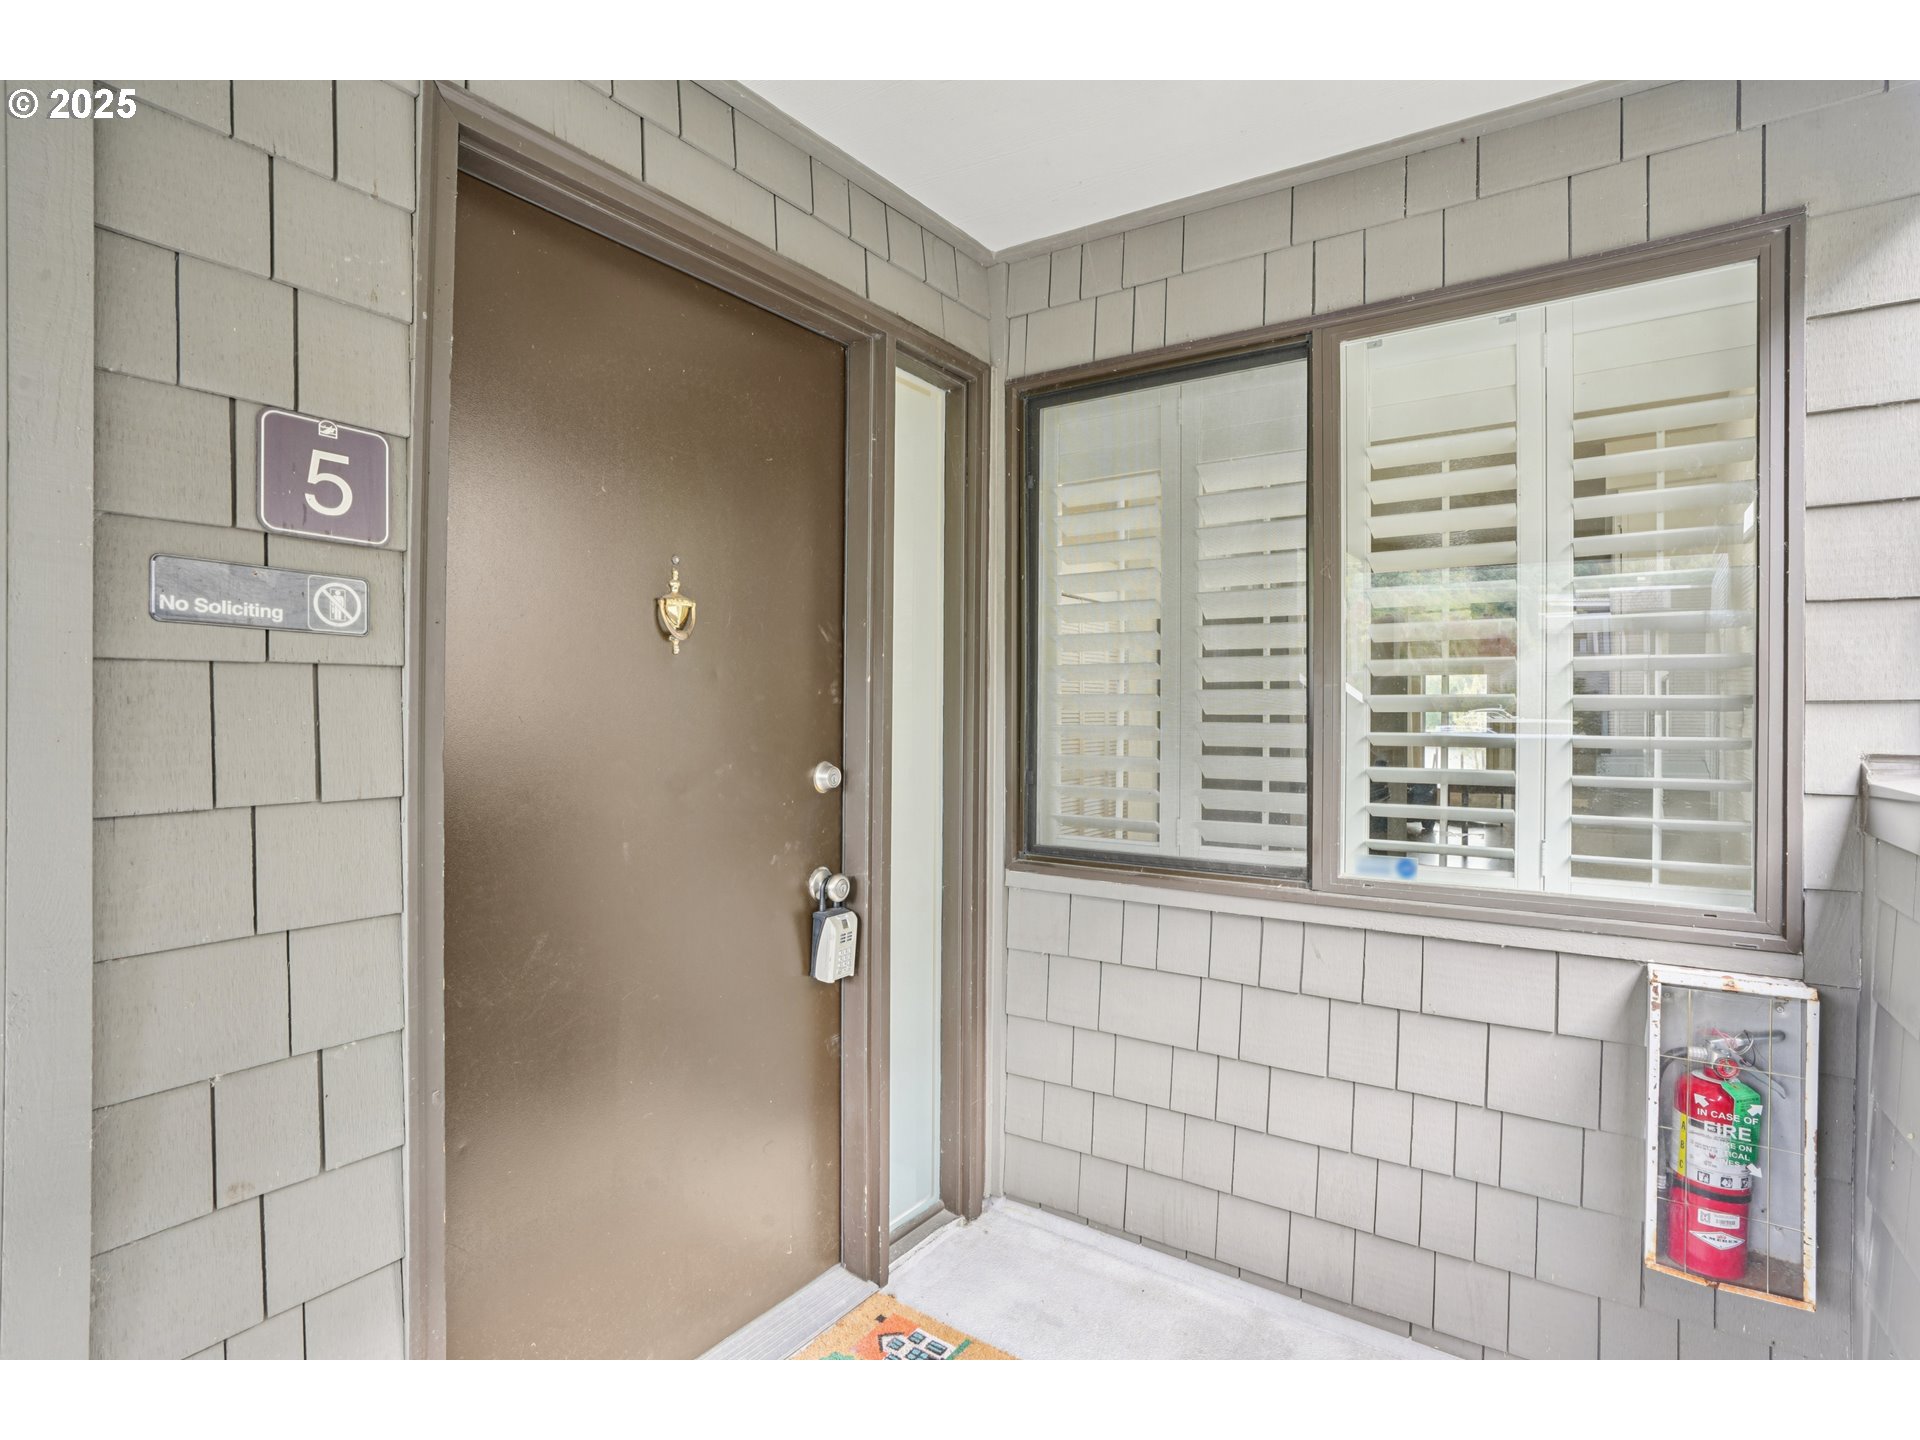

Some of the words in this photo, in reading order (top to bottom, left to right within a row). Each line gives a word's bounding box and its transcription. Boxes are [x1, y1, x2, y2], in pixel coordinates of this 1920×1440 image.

[304, 448, 353, 516] 5
[159, 593, 189, 612] No
[194, 597, 284, 623] Soliciting
[1697, 1107, 1708, 1117] IN
[1710, 1110, 1741, 1123] CASE
[1743, 1116, 1759, 1126] OF
[1703, 1120, 1752, 1142] FIRE
[1738, 1144, 1753, 1153] ON
